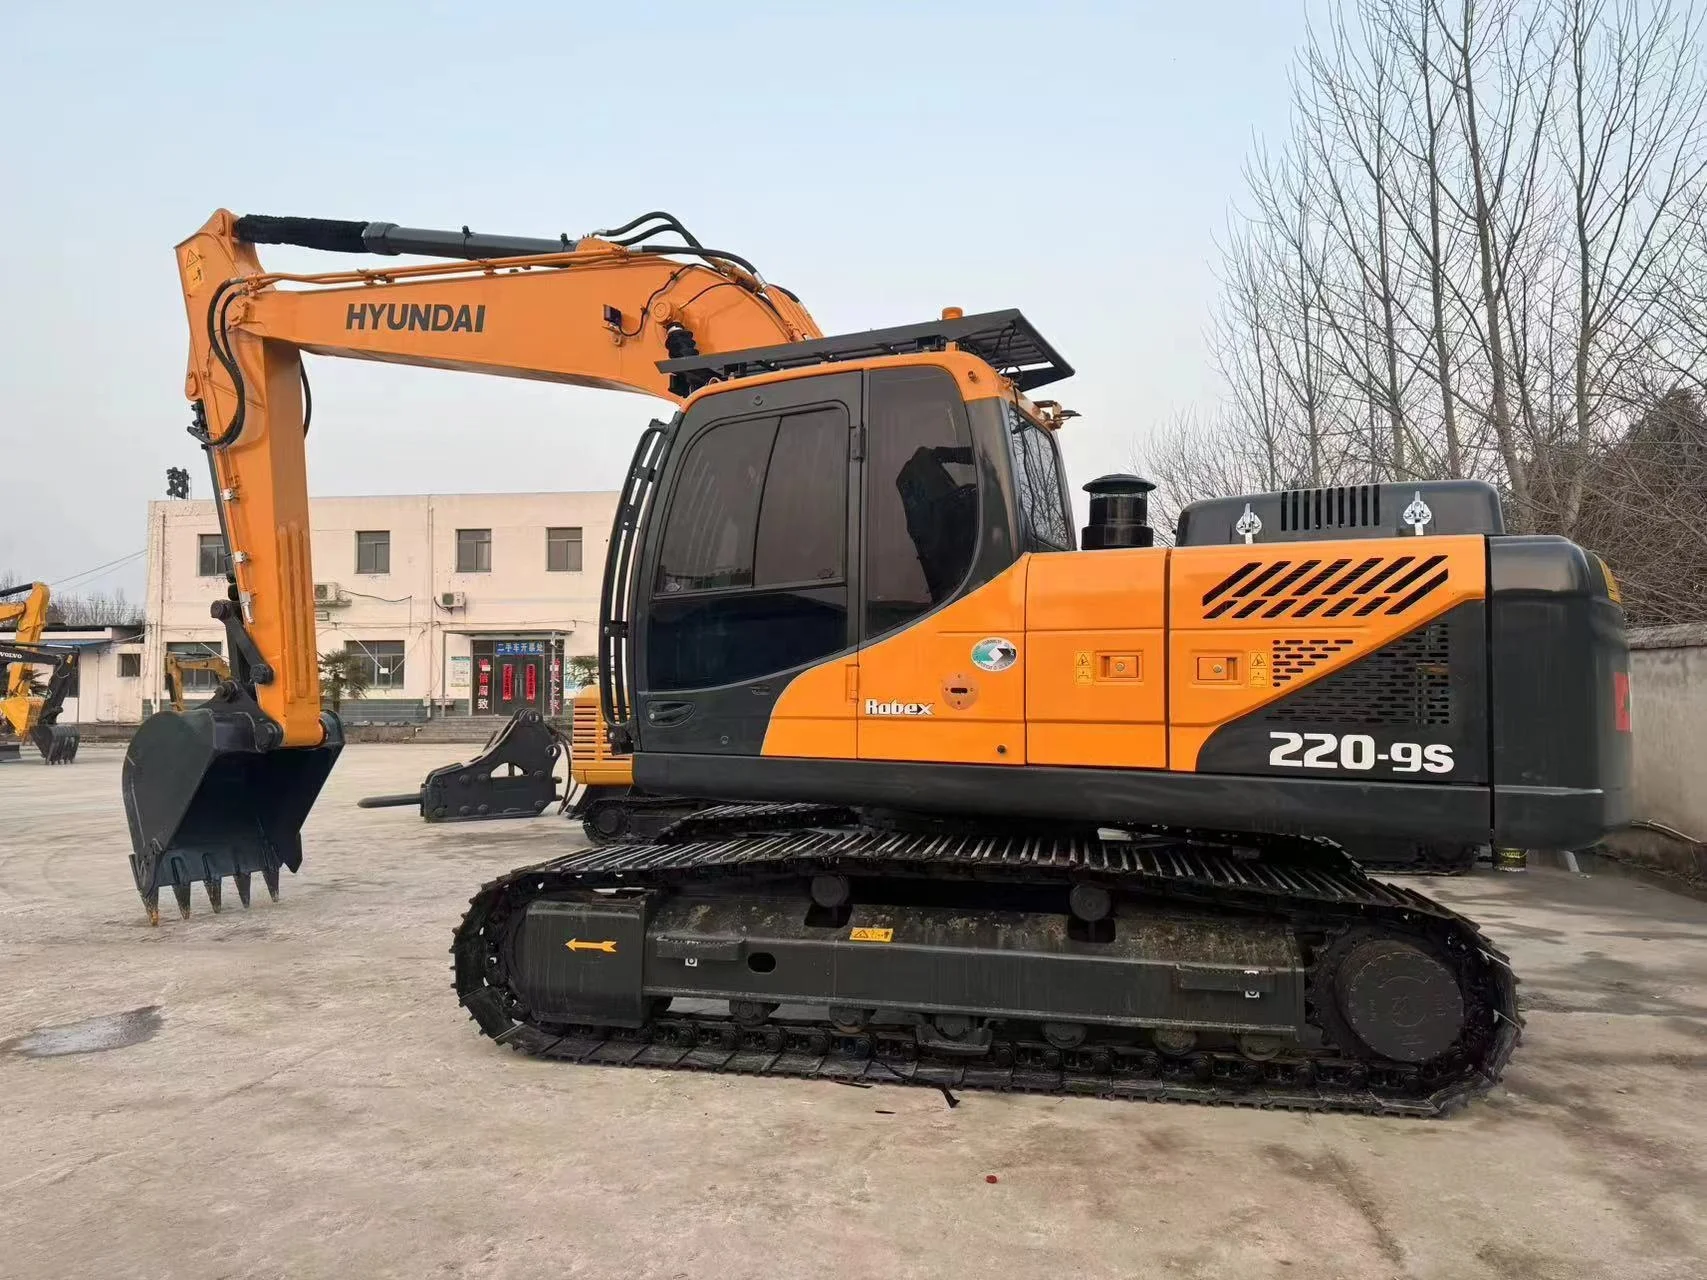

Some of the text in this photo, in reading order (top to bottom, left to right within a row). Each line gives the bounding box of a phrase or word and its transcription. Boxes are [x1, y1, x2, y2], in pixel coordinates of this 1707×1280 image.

[345, 303, 486, 333] HYUNDAI
[0, 651, 23, 659] VOLVO
[865, 698, 936, 716] Robex
[1269, 731, 1455, 774] 220-9S
